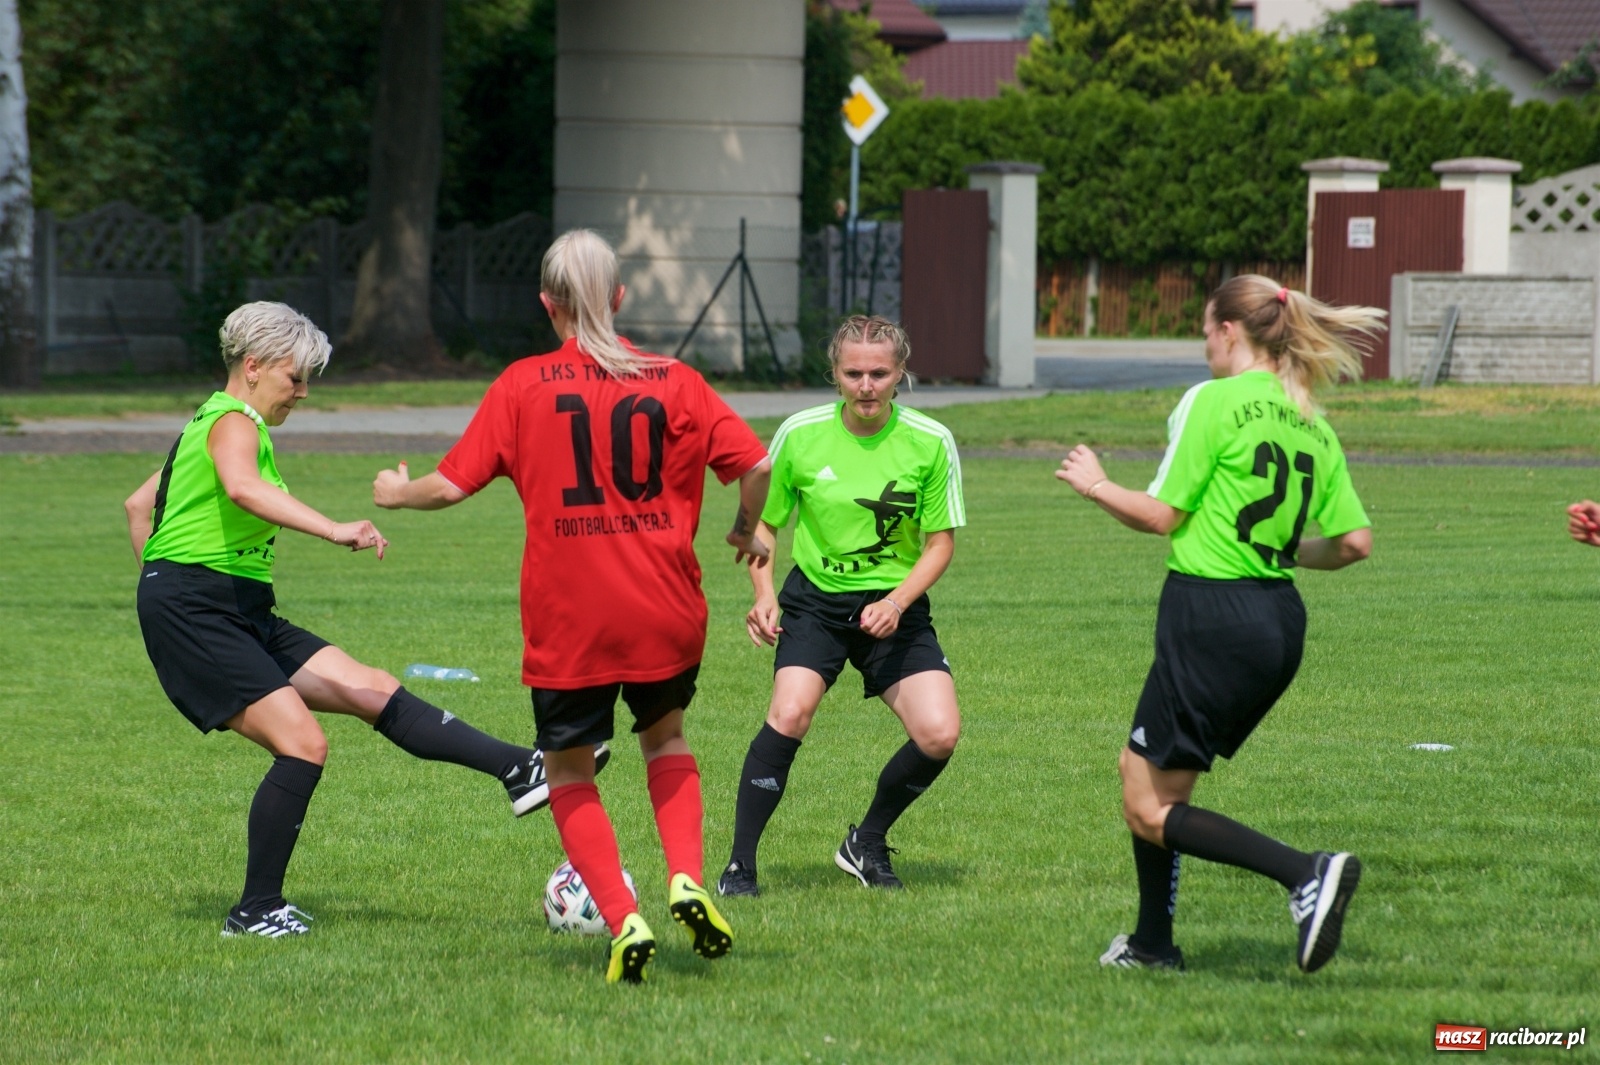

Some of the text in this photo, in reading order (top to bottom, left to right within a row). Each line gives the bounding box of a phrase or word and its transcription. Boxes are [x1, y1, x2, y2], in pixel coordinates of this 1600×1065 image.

[540, 363, 576, 383] LKS
[1234, 400, 1264, 429] LKS
[555, 393, 668, 508] 10
[1235, 440, 1315, 570] 21
[554, 511, 675, 538] FOOTBALLCENTER.PL
